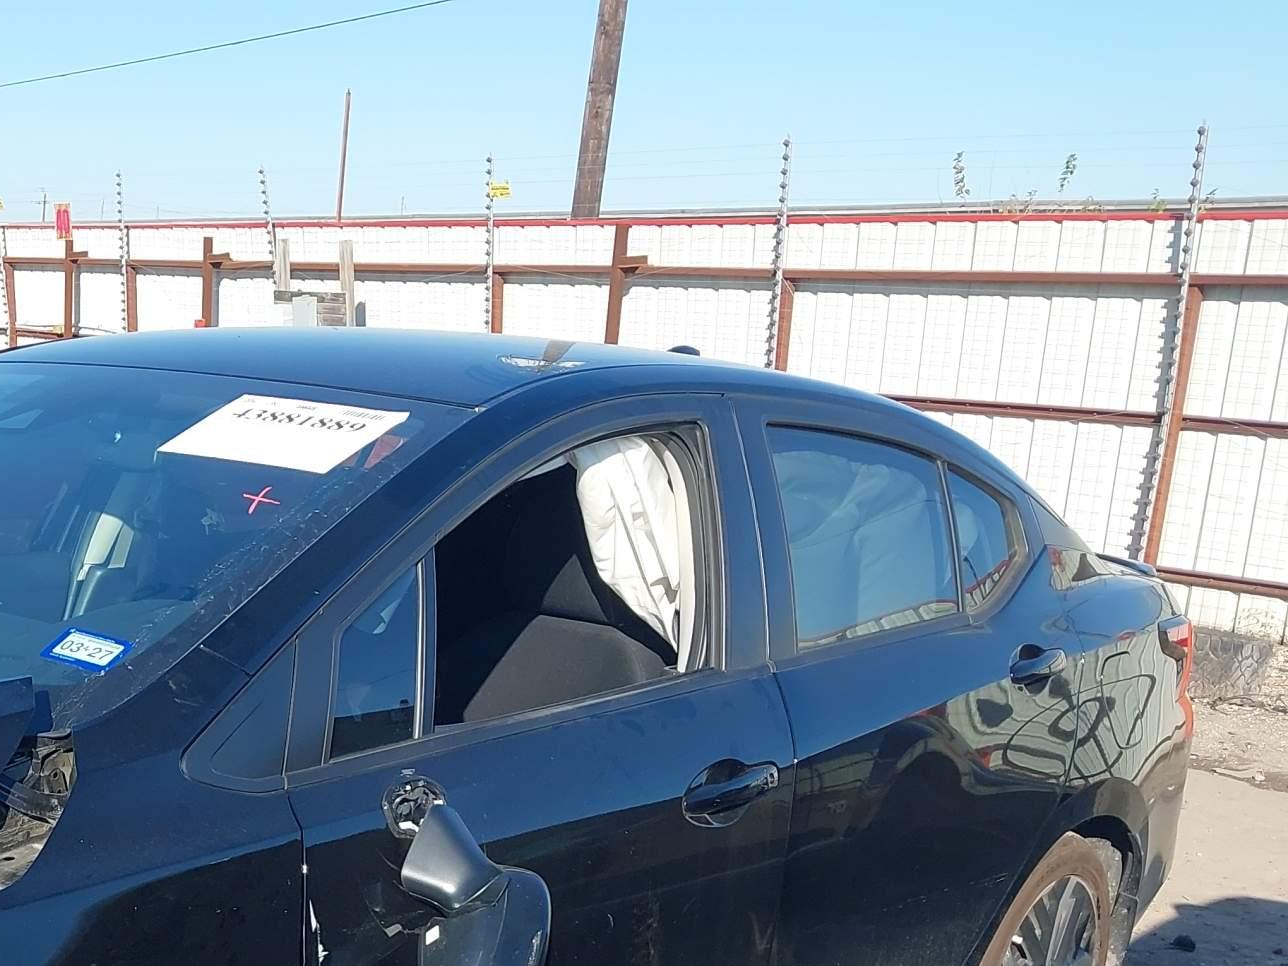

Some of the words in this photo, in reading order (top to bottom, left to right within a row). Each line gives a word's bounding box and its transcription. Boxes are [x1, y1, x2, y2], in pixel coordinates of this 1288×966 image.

[232, 408, 367, 432] 43881889
[60, 640, 85, 653] 03
[86, 647, 114, 660] 27
